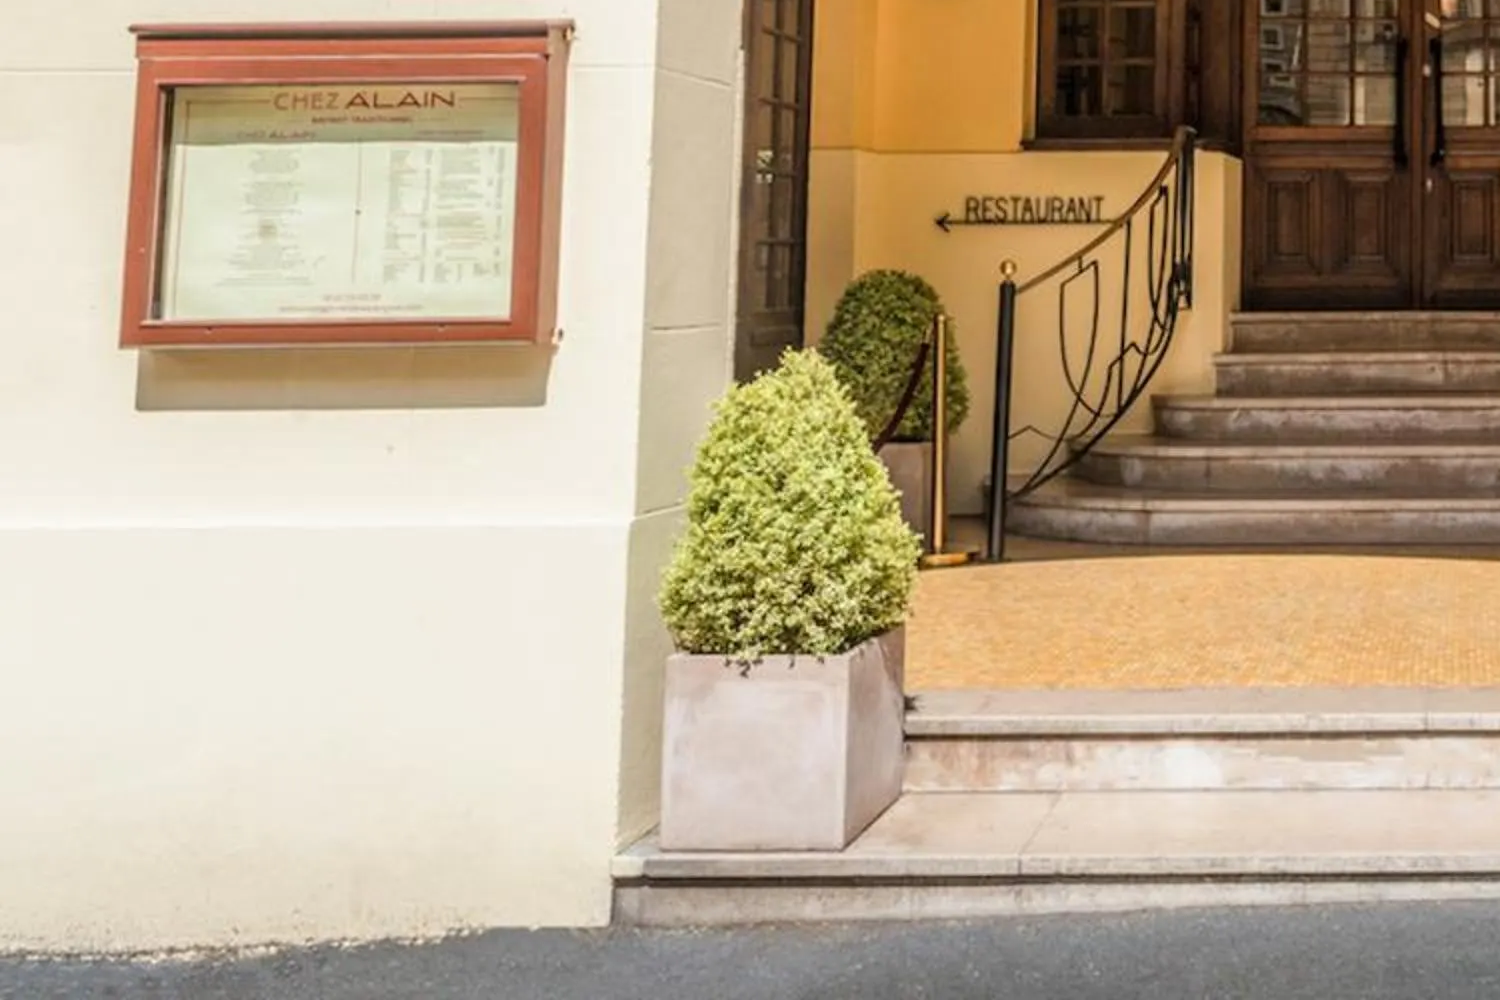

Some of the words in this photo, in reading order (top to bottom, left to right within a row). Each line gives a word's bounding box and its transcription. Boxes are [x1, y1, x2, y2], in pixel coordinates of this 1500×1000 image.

[273, 92, 339, 111] CHEZ
[345, 91, 455, 109] ALAIN
[965, 196, 1104, 223] RESTAURANT
